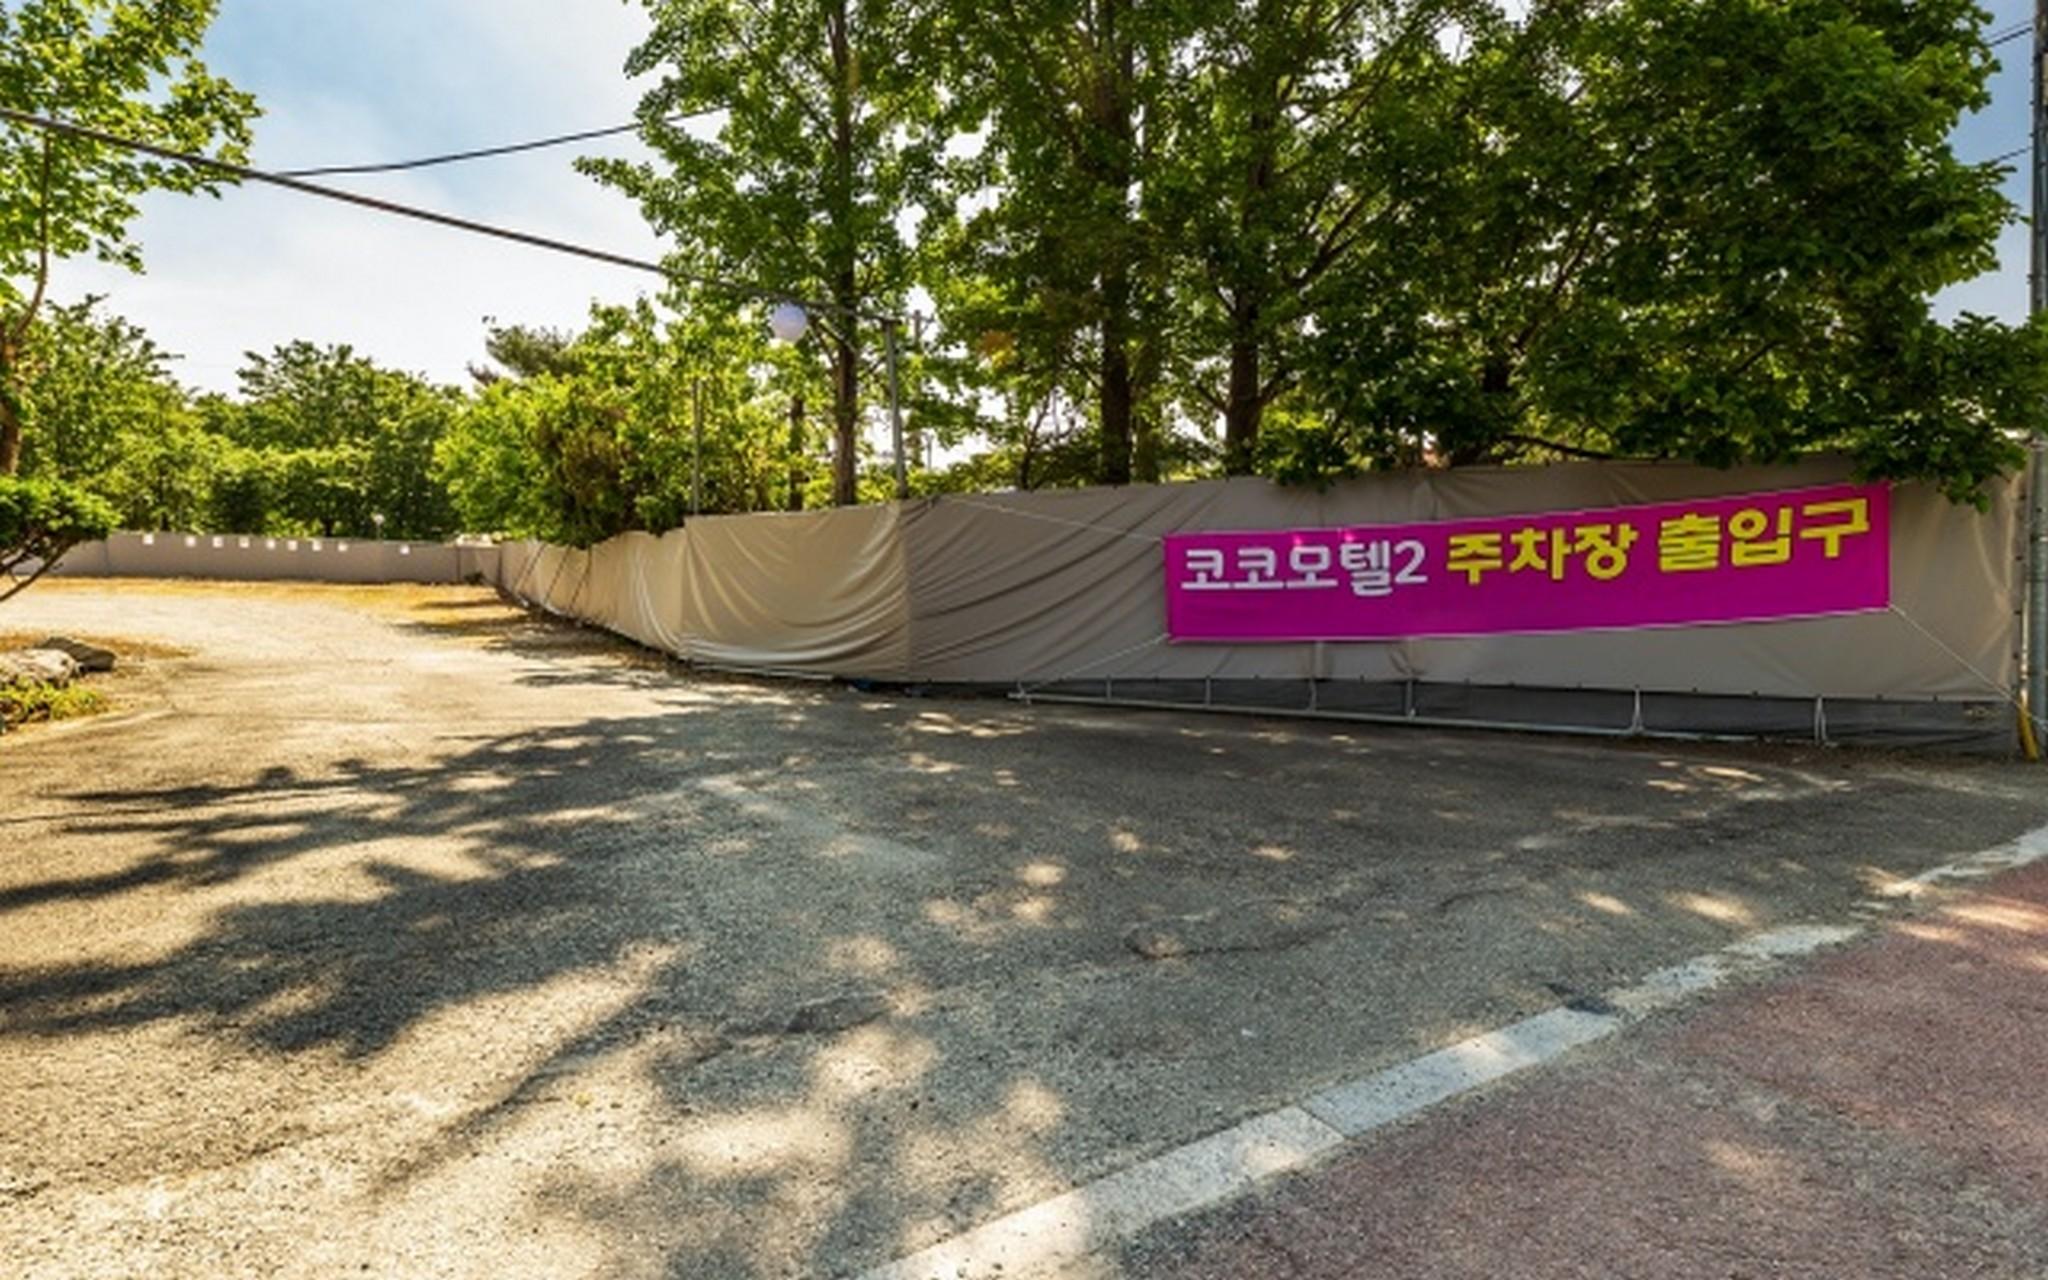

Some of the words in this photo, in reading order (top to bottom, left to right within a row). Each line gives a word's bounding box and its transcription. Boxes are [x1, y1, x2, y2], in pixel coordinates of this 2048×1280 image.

[1181, 541, 1428, 595] 코코모텔2
[1446, 524, 1638, 586] 주차장
[1658, 498, 1870, 572] 출입구
